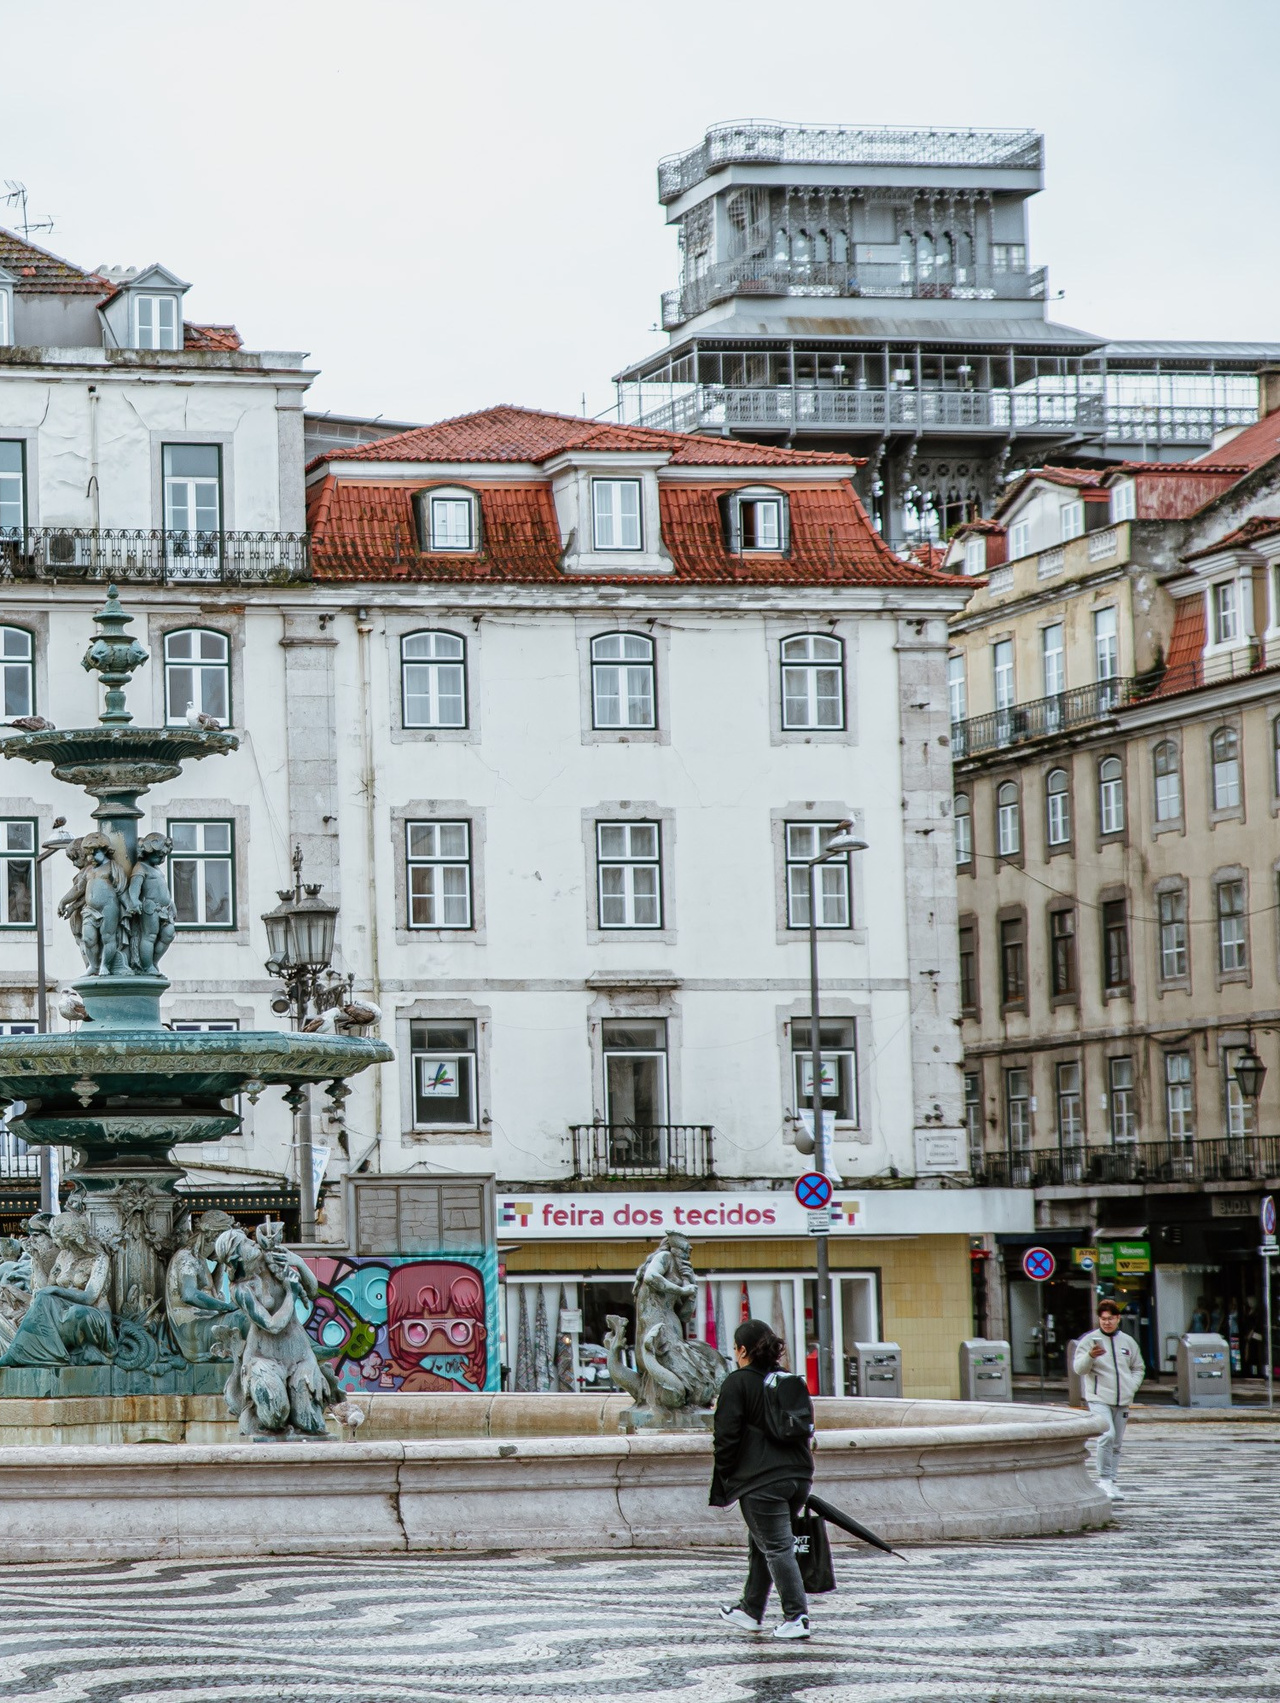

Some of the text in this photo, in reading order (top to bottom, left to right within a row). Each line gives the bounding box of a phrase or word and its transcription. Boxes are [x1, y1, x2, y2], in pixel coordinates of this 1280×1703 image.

[542, 1202, 777, 1226] feira dos tecidos
[793, 1544, 810, 1553] NE
